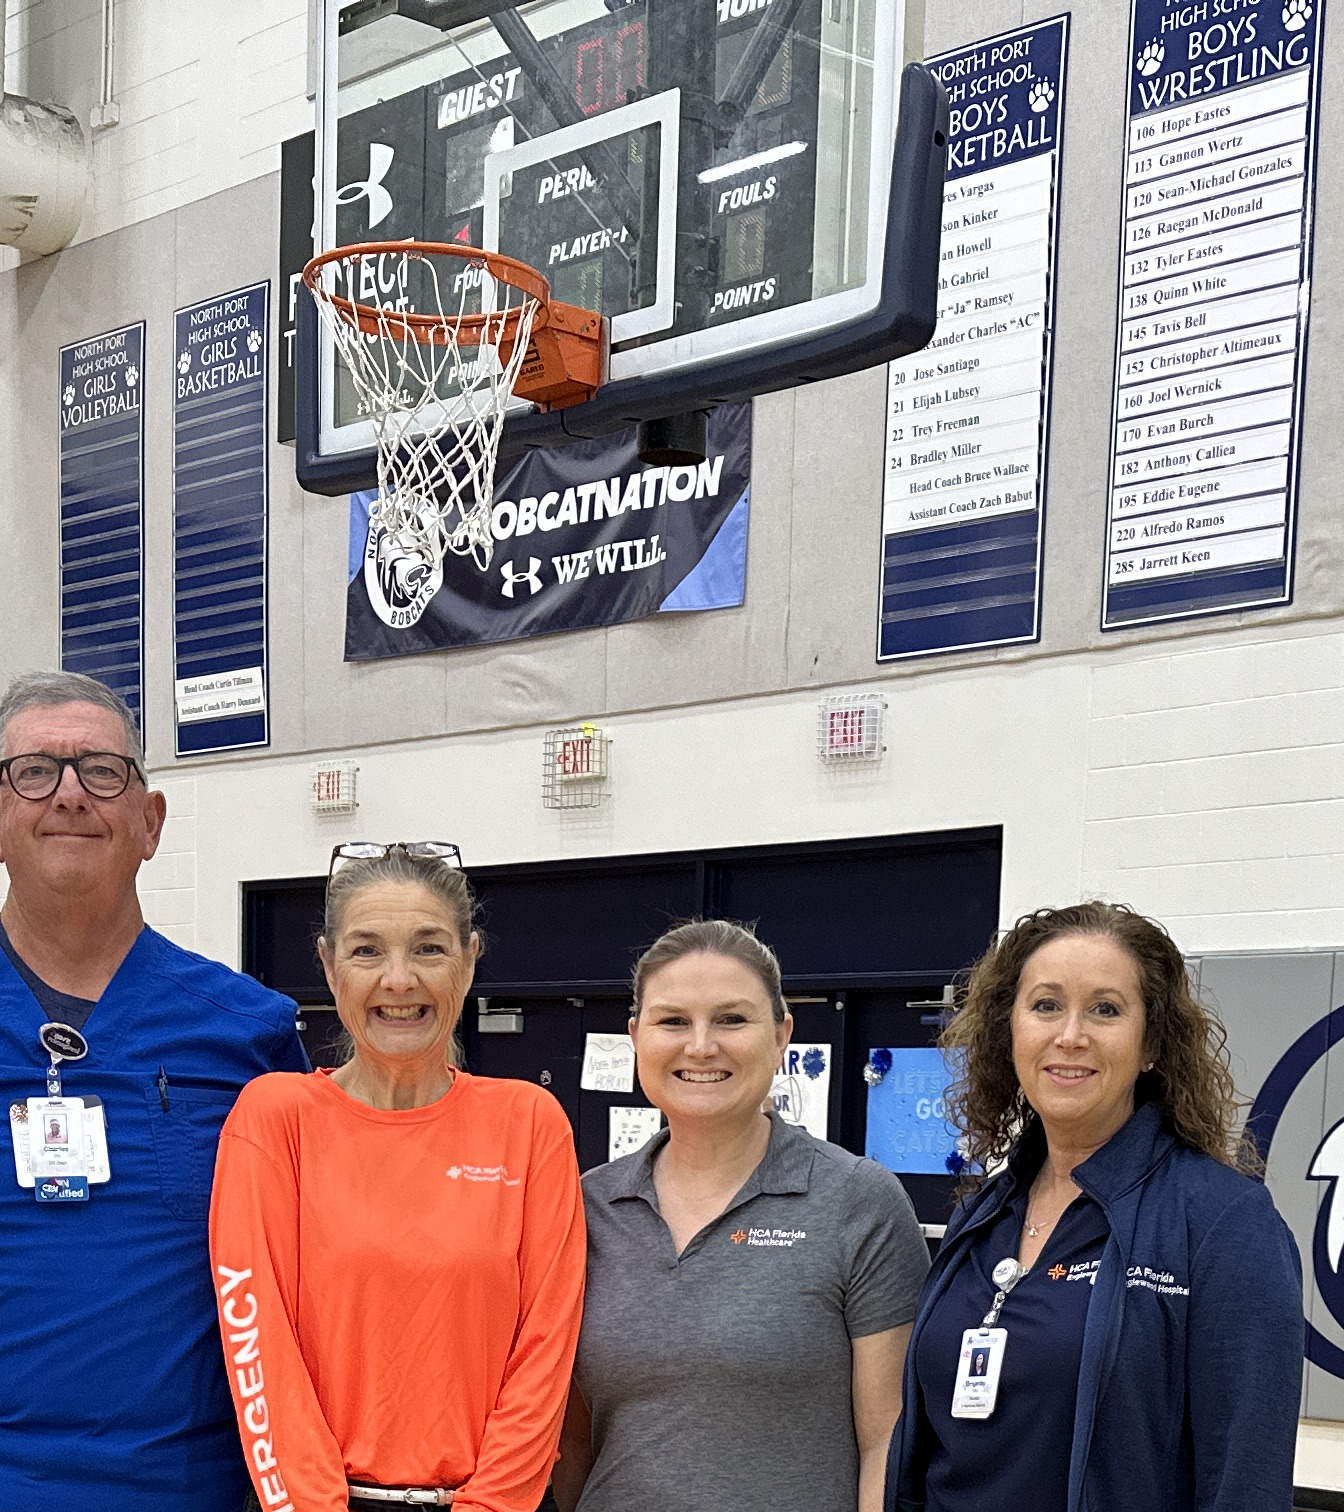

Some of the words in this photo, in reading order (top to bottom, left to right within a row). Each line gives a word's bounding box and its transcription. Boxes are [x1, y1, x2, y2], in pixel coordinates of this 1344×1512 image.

[1161, 6, 1206, 33] HIGH
[1188, 13, 1257, 60] BOYS
[930, 51, 986, 81] NORTH
[991, 37, 1035, 67] PORT
[1138, 34, 1308, 109] WRESTLING
[970, 62, 1036, 98] SCHOOL
[438, 67, 521, 129] GUEST
[949, 95, 1008, 136] BOYS
[1136, 124, 1155, 141] 106
[1162, 114, 1191, 135] Hope
[1194, 104, 1231, 128] Eastes
[948, 116, 1052, 171] KETBALL
[1134, 157, 1152, 174] 113
[1160, 148, 1205, 168] Gannon
[1208, 135, 1243, 159] Wertz
[718, 177, 777, 213] FOULS
[960, 181, 994, 197] Vargas
[1133, 191, 1152, 208] 120
[1158, 171, 1236, 202] Sean-Michael
[1239, 156, 1292, 183] Gonzales
[963, 208, 998, 227] Kinker
[1132, 226, 1151, 243] 126
[1157, 216, 1199, 238] Raegan
[1202, 198, 1263, 223] McDonald
[956, 237, 992, 257] Howell
[1130, 260, 1149, 276] 132
[1155, 251, 1184, 271] Tyler
[1187, 242, 1223, 262] Eastes
[951, 267, 989, 287] Gabriel
[1129, 293, 1147, 309] 138
[1154, 284, 1188, 305] Quinn
[1192, 275, 1226, 294] White
[711, 278, 775, 313] POINTS
[974, 291, 1014, 306] Ramsey
[191, 305, 223, 326] NORTH
[225, 296, 248, 315] PORT
[188, 326, 212, 345] HIGH
[213, 315, 250, 340] SCHOOL
[968, 321, 1007, 339] Charles
[1128, 326, 1147, 342] 145
[1153, 320, 1181, 336] Tavis
[1185, 313, 1206, 330] Bell
[74, 344, 103, 361] NORTH
[105, 333, 126, 352] PORT
[201, 337, 237, 365] GIRLS
[1126, 359, 1144, 375] 152
[1151, 344, 1218, 372] Christopher
[1221, 332, 1282, 355] Altimeaux
[72, 362, 94, 378] HIGH
[95, 351, 128, 373] SCHOOL
[177, 355, 261, 399] BASKETBALL
[914, 366, 934, 382] Jose
[936, 356, 980, 379] Santiago
[83, 372, 116, 398] GIRLS
[913, 393, 942, 411] Elijah
[944, 384, 980, 405] Lubsey
[1124, 394, 1142, 410] 160
[1149, 388, 1172, 405] Joel
[1174, 377, 1222, 400] Wernick
[62, 390, 139, 428] VOLLEYBALL
[912, 423, 933, 441] Trey
[937, 413, 980, 435] Freeman
[1122, 427, 1141, 444] 170
[1147, 420, 1174, 438] Evan
[1179, 412, 1213, 434] Burch
[891, 456, 902, 469] 24
[910, 448, 948, 468] Bradley
[952, 441, 982, 460] Miller
[1121, 460, 1138, 477] 182
[1144, 452, 1192, 474] Anthony
[1118, 493, 1137, 509] 195
[1143, 487, 1174, 505] Eddie
[1177, 479, 1220, 502] Eugene
[1117, 527, 1135, 543] 220
[1141, 519, 1182, 538] Alfredo
[1186, 512, 1225, 531] Ramos
[552, 554, 593, 585] WE
[594, 534, 666, 576] WILL.
[1115, 560, 1134, 575] 285
[1140, 553, 1176, 572] Jarrett
[1180, 549, 1210, 566] Keen
[391, 585, 434, 626] BOBCATS
[828, 709, 865, 749] EXIT
[563, 738, 591, 774] EXIT
[749, 1228, 771, 1238] HCA
[772, 1229, 806, 1239] Florida
[1069, 1263, 1090, 1273] HCA
[1144, 1268, 1174, 1282] Florida
[1158, 1284, 1189, 1296] Hospital
